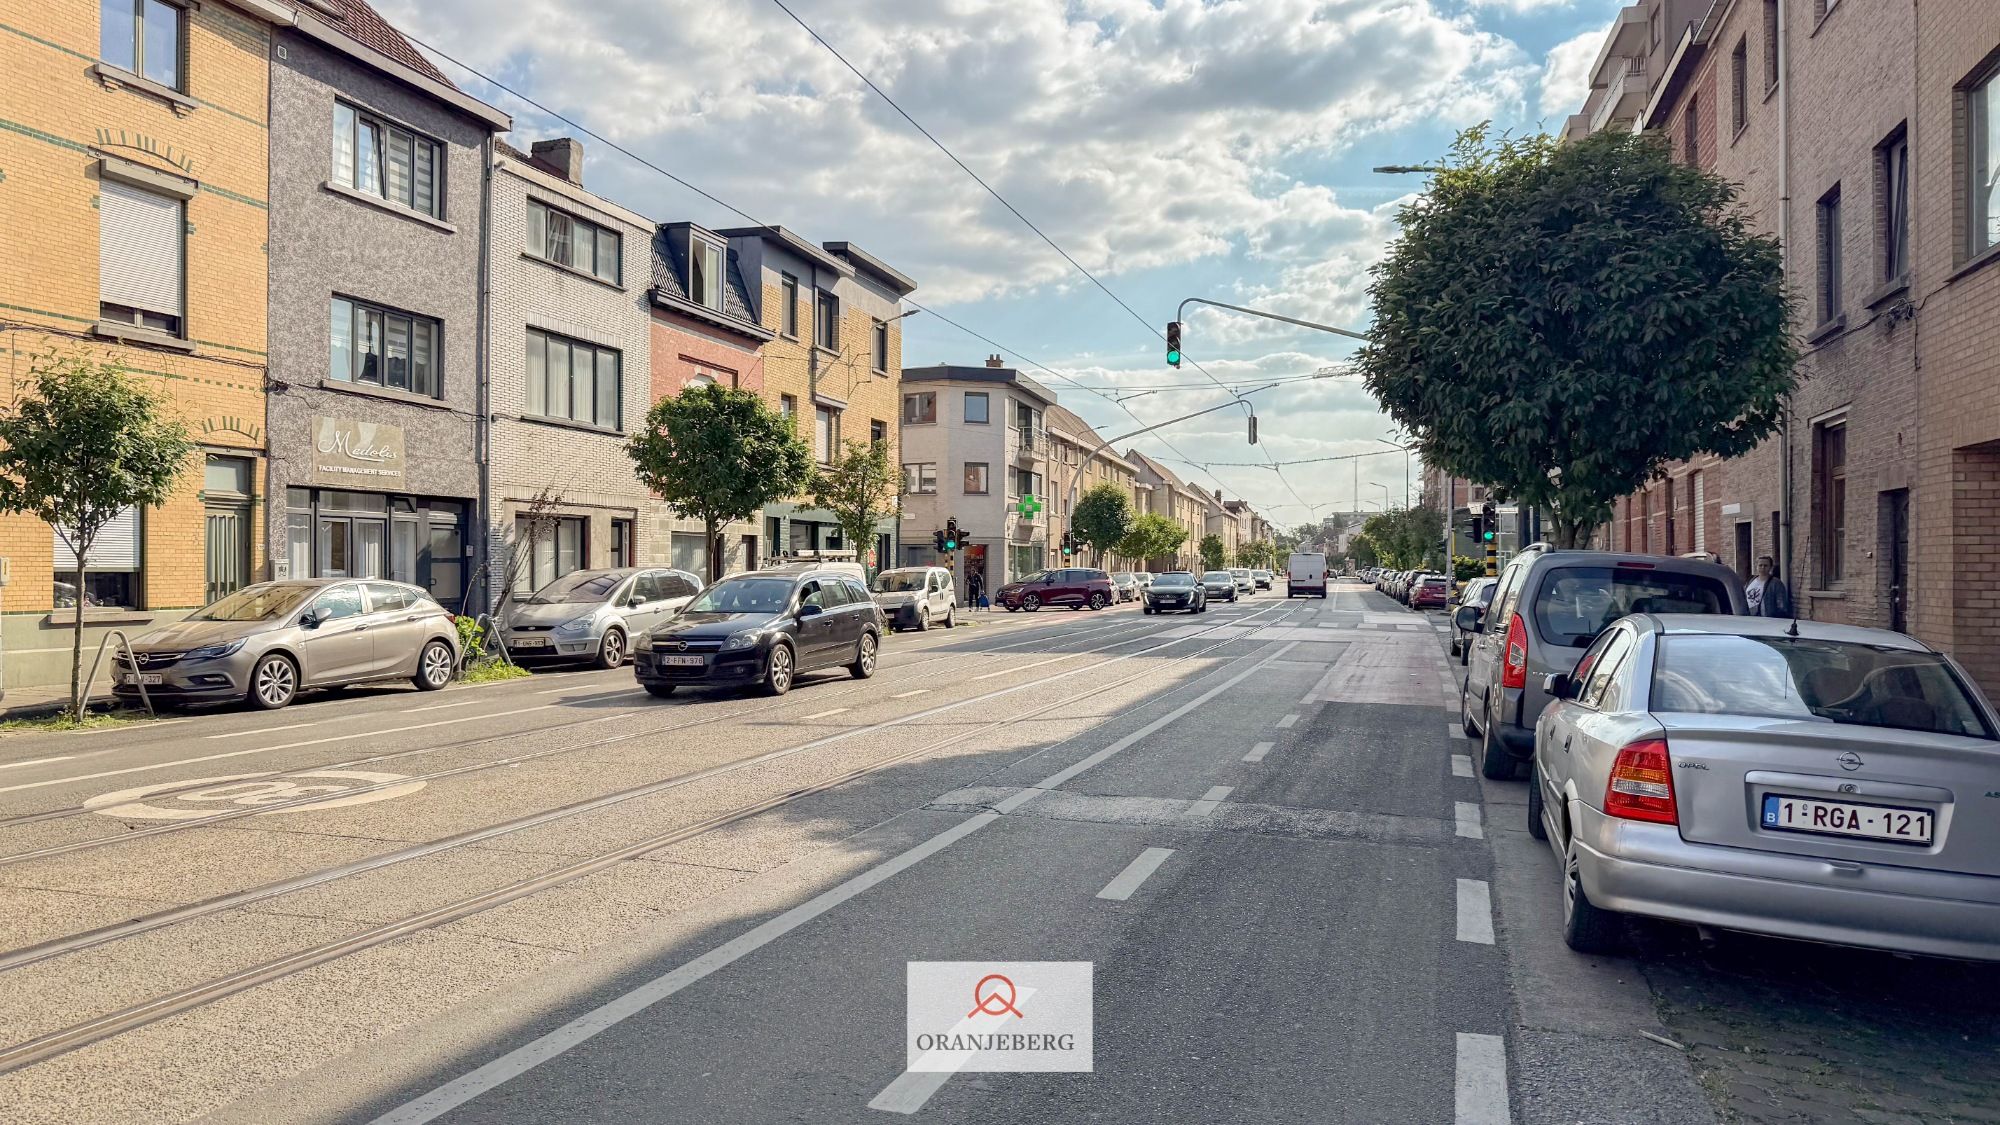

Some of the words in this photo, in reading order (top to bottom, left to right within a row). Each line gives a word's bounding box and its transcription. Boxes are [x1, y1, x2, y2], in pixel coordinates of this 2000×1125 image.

[318, 464, 342, 473] FACILITY
[342, 466, 377, 476] MANAGEMENT
[377, 469, 401, 477] SERVICES
[1678, 761, 1710, 771] OPEL
